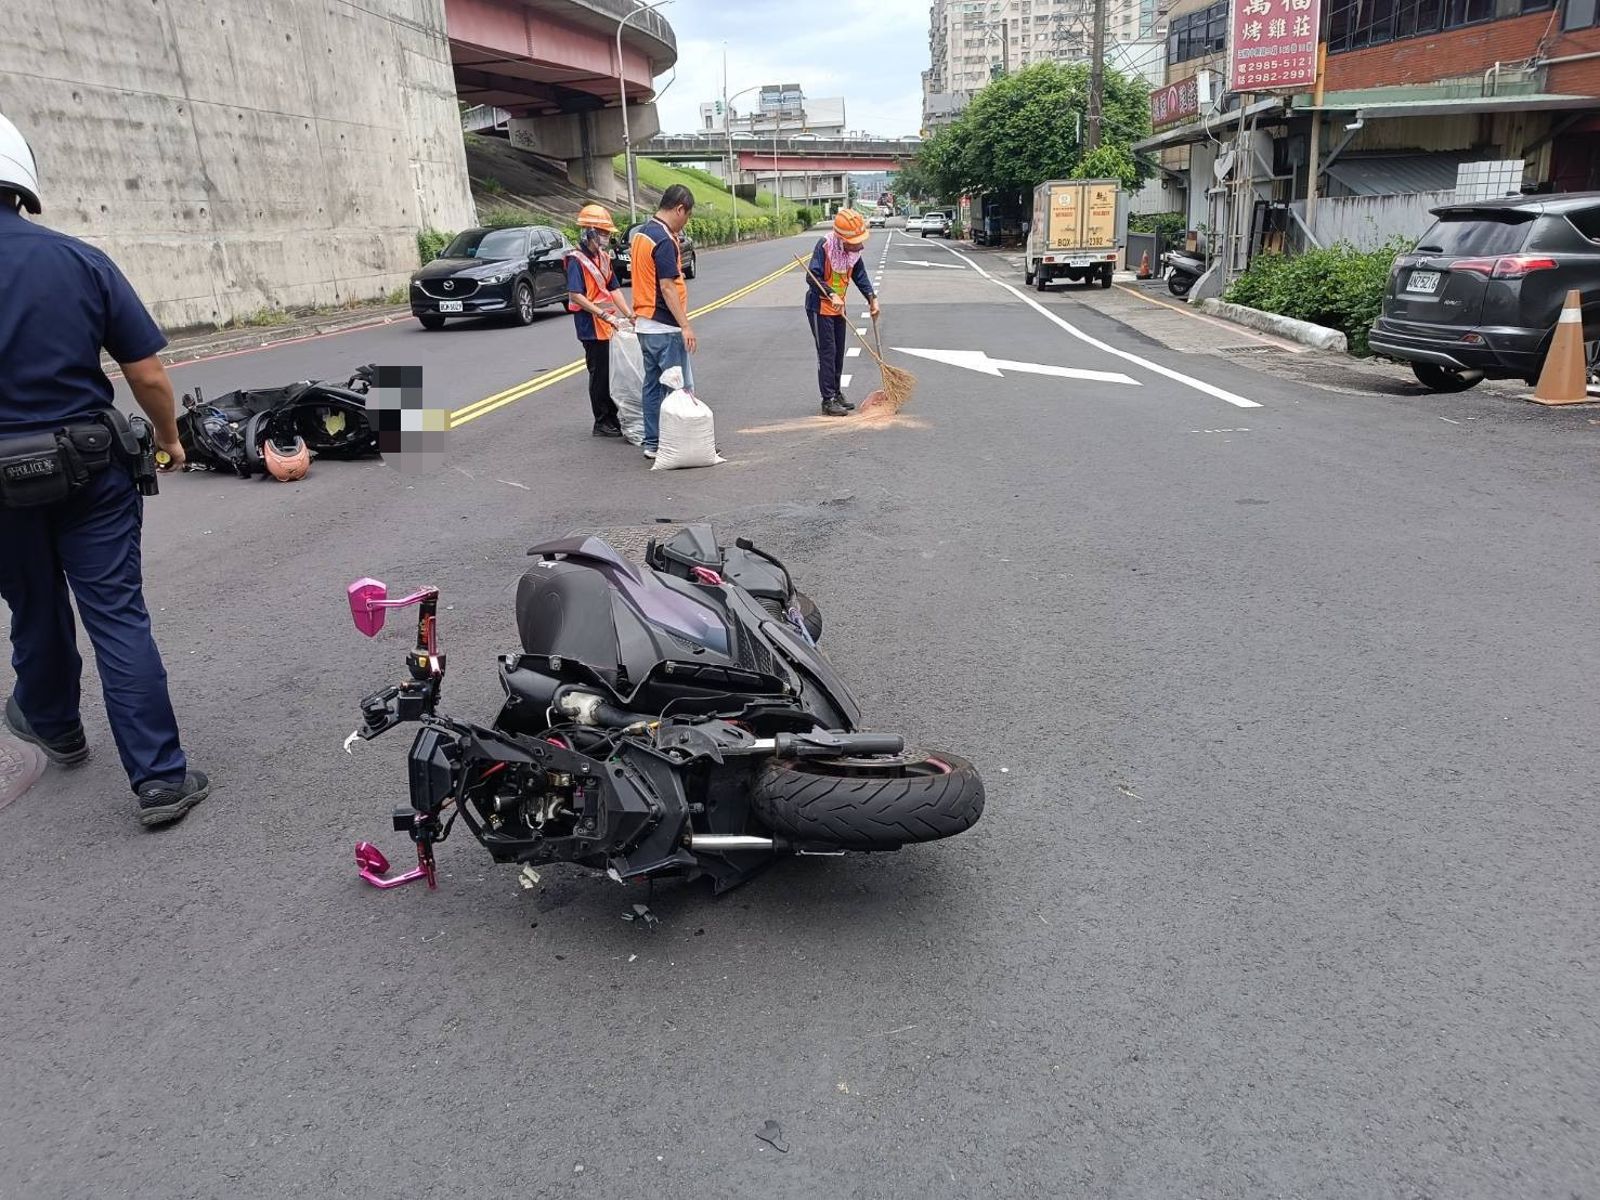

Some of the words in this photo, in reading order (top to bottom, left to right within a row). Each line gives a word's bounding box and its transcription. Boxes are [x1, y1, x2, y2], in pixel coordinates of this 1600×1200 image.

[1242, 15, 1311, 41] 烤雞莊
[1248, 56, 1312, 71] 2985-5121
[1247, 69, 1311, 83] 2982-2991
[14, 461, 44, 476] POLICE
